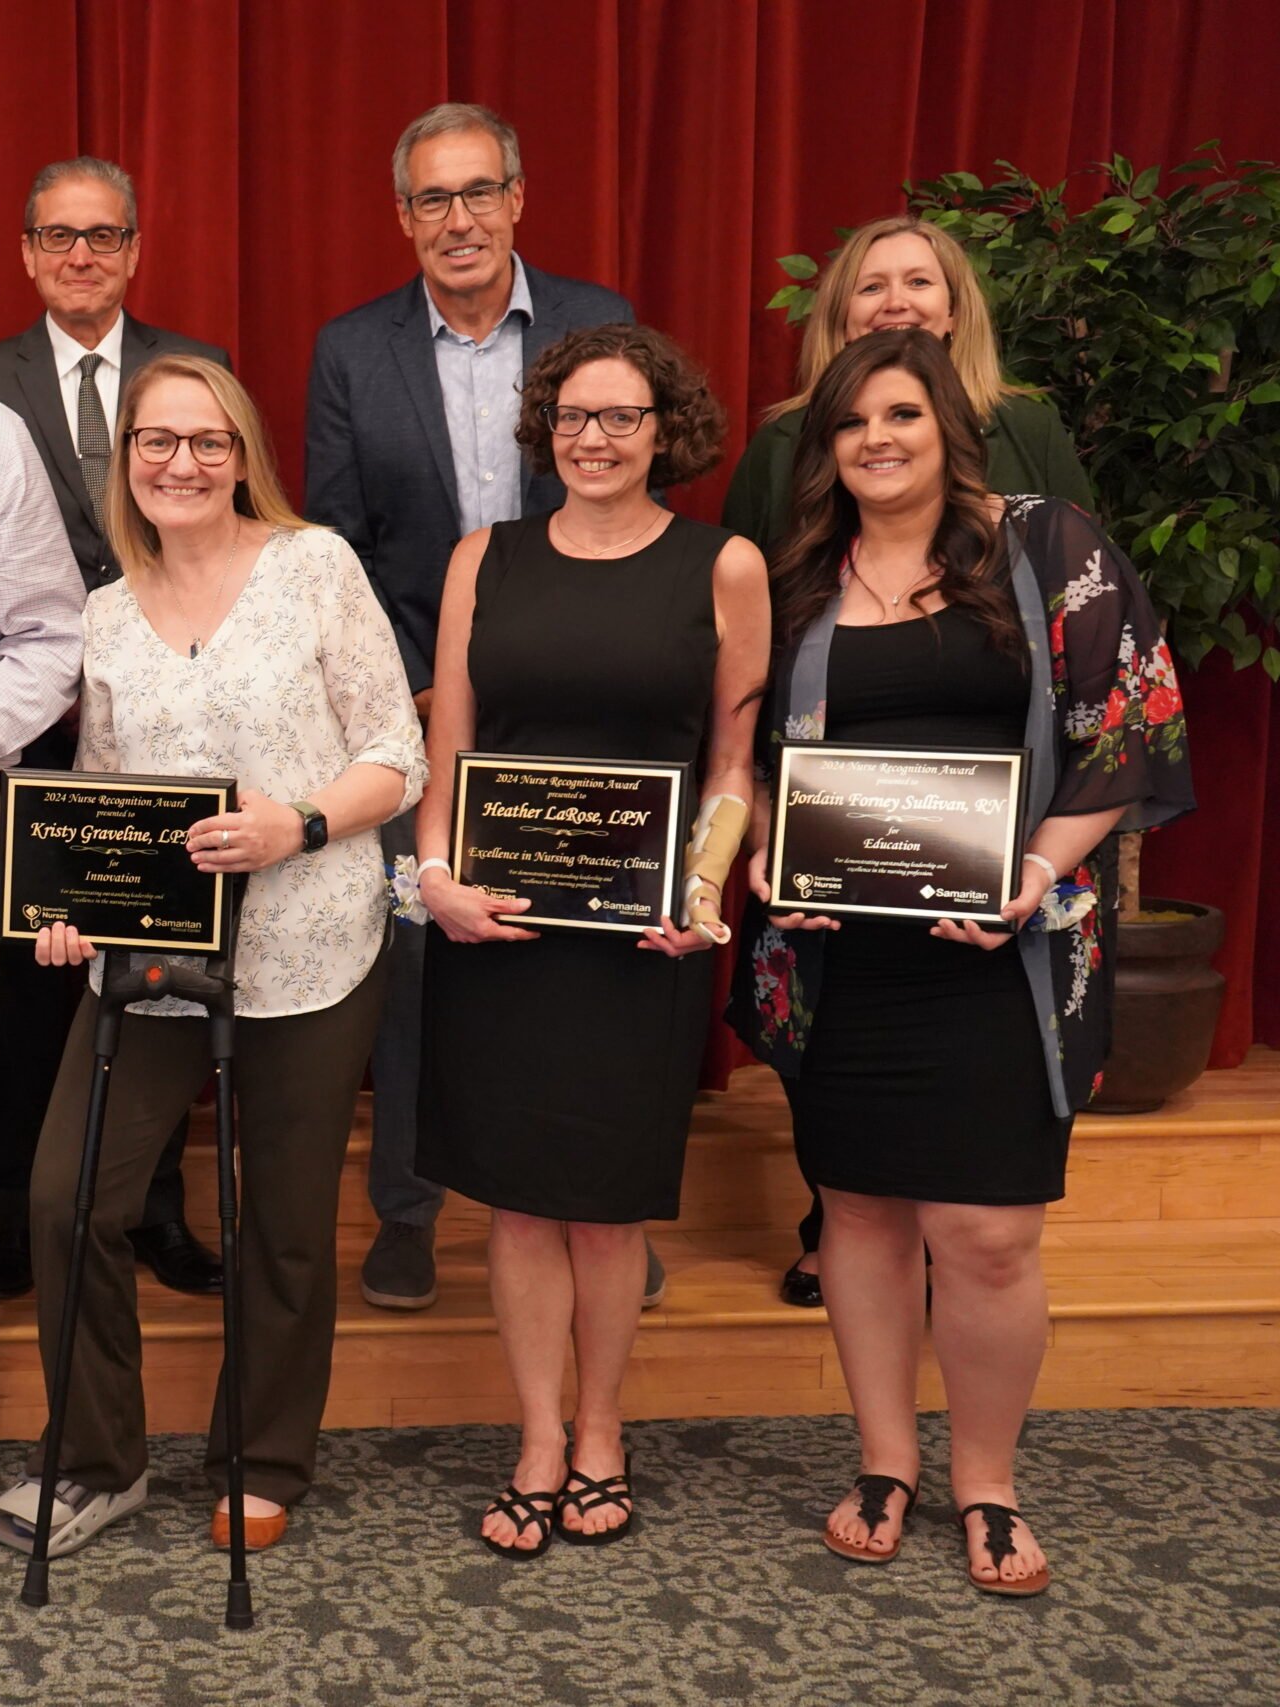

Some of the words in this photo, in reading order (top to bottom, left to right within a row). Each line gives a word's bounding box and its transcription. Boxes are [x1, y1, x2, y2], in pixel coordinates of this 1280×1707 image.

[821, 760, 844, 770] 2024
[846, 762, 877, 772] Nurse
[879, 762, 938, 776] Recognition
[938, 765, 978, 776] Award
[495, 774, 518, 784] 2024
[520, 775, 548, 785] Nurse
[550, 776, 604, 789] Recognition
[605, 779, 641, 791] Award
[876, 778, 911, 786] presented
[44, 792, 67, 802] 2024
[69, 793, 96, 804] Nurse
[98, 795, 152, 808] Recognition
[153, 797, 189, 809] Award
[547, 792, 577, 800] presented
[788, 790, 844, 807] Jordain
[849, 793, 899, 813] Forney
[902, 795, 969, 814] Sullivan,
[974, 798, 1007, 814] RN
[96, 810, 127, 818] presented
[482, 802, 542, 819] Heather
[544, 807, 603, 825] LaRose,
[608, 810, 651, 826] LPN
[30, 822, 77, 843] Kristy
[81, 825, 153, 844] Graveline,
[887, 826, 899, 836] for
[557, 841, 568, 849] for
[863, 838, 921, 851] Education
[109, 859, 119, 868] for
[468, 847, 518, 860] Excellence
[521, 852, 531, 861] in
[534, 852, 574, 866] Nursing
[577, 854, 621, 868] Practice;
[624, 858, 660, 870] Clinics
[86, 871, 141, 883] Innovation
[814, 881, 842, 889] Nurses
[936, 888, 988, 899] Samaritan
[603, 901, 651, 912] Samaritan
[155, 918, 201, 928] Samaritan
